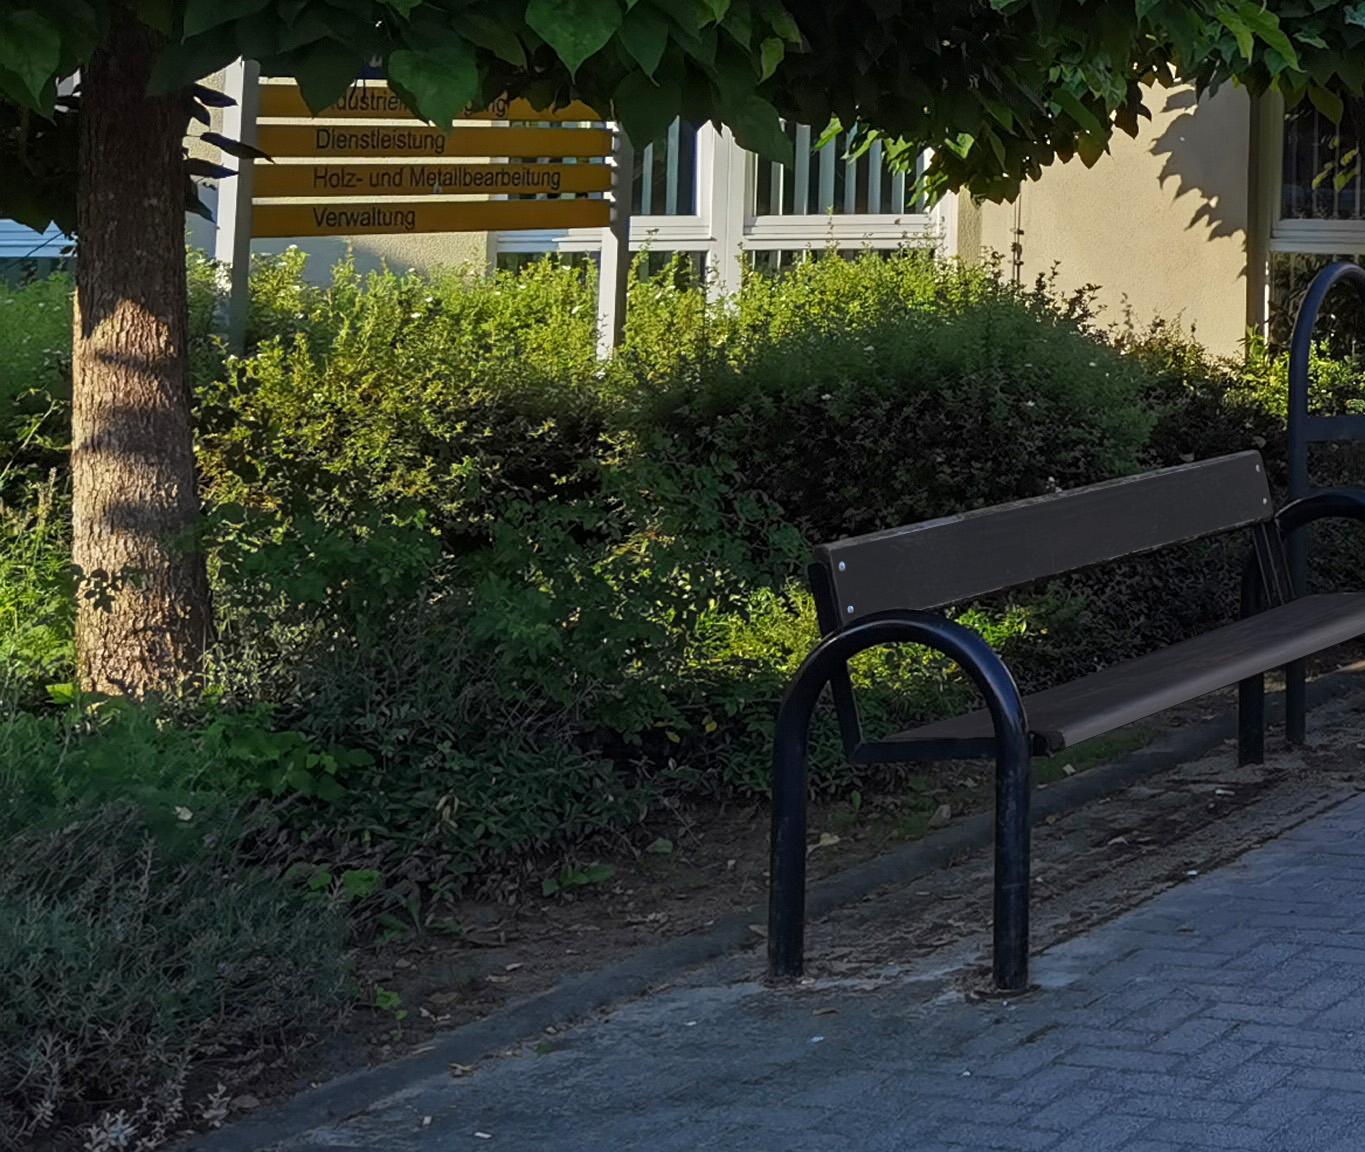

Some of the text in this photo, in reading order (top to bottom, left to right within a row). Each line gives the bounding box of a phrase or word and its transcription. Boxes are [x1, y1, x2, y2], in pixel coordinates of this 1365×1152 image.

[317, 128, 446, 153] Dienstleistung
[313, 165, 561, 190] Holz- und Metallbearbeitung
[313, 206, 416, 231] Verwaltung
